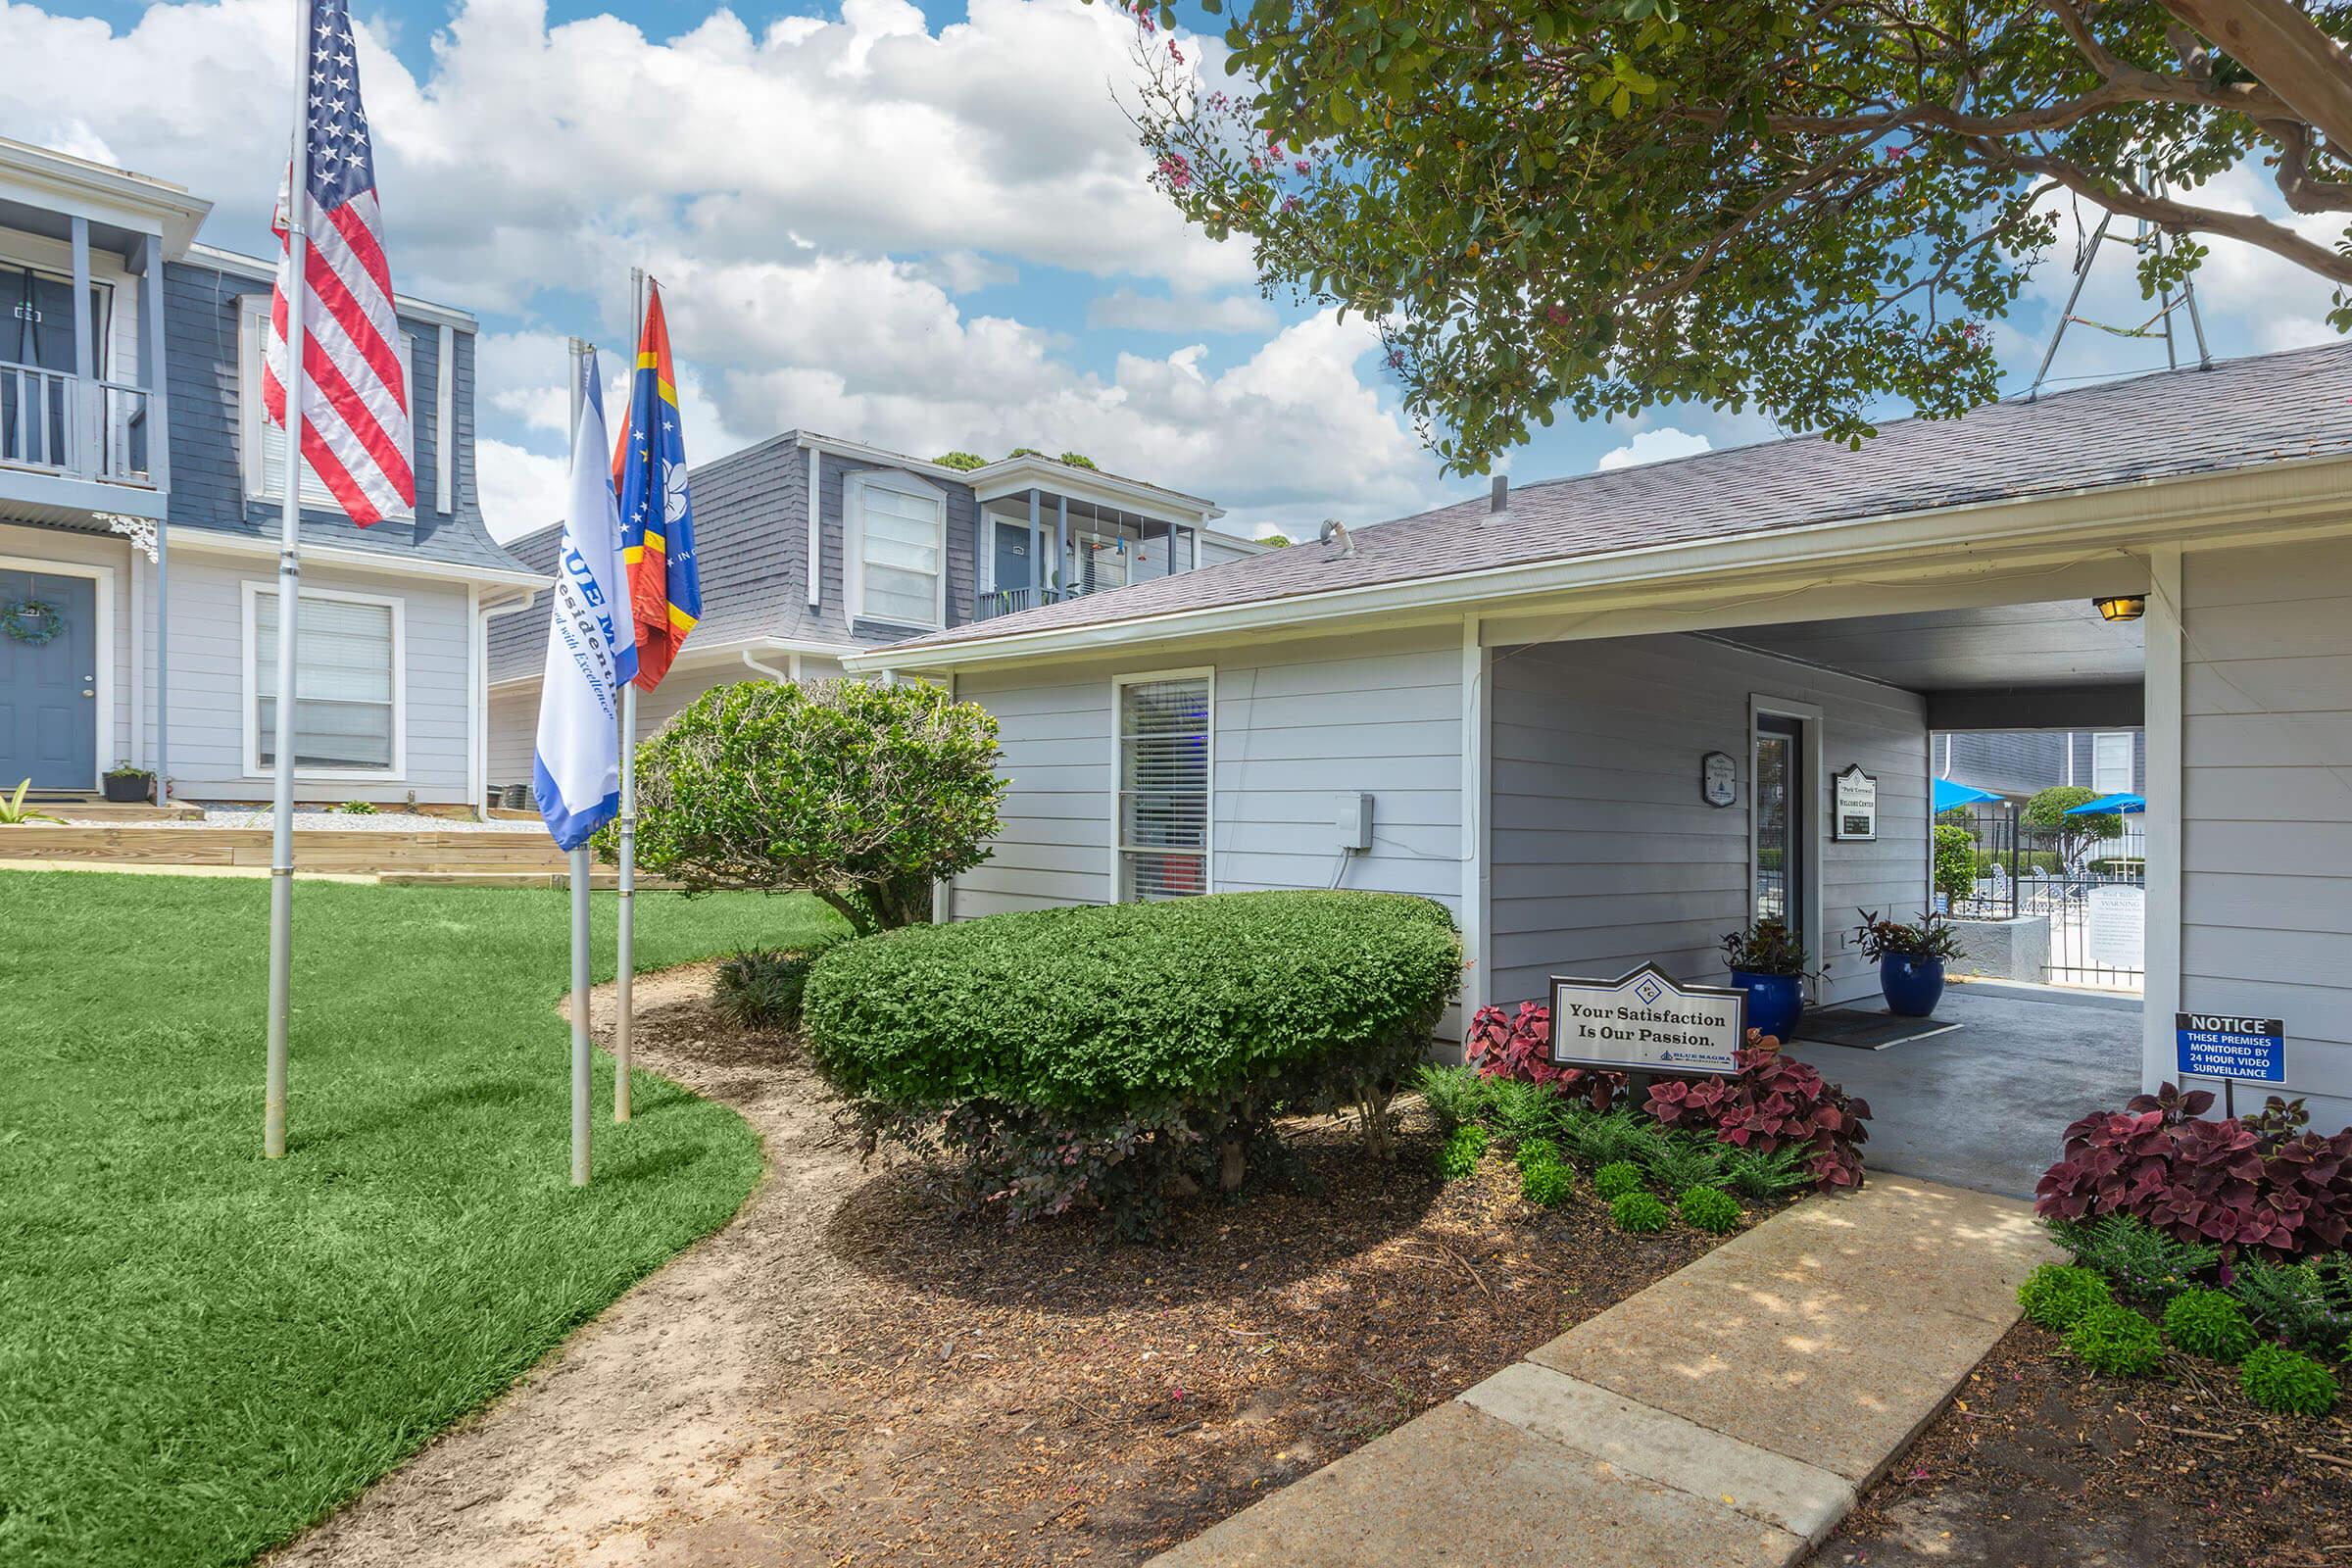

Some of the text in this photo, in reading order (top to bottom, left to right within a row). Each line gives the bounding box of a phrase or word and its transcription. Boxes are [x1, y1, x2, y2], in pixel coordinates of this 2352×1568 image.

[677, 551, 691, 562] IN
[560, 545, 606, 608] UE
[560, 627, 580, 650] with
[1569, 1004, 1726, 1027] Your Satisfaction
[2191, 1016, 2266, 1034] NOTICE
[1579, 1025, 1715, 1047] Is Our Passion.
[2187, 1032, 2272, 1047] THESE PREMISES
[2190, 1043, 2270, 1057] MONITORED BY
[2189, 1053, 2271, 1067] 24 HOUR VIDEO
[2192, 1063, 2267, 1078] SURVEILLANCE
